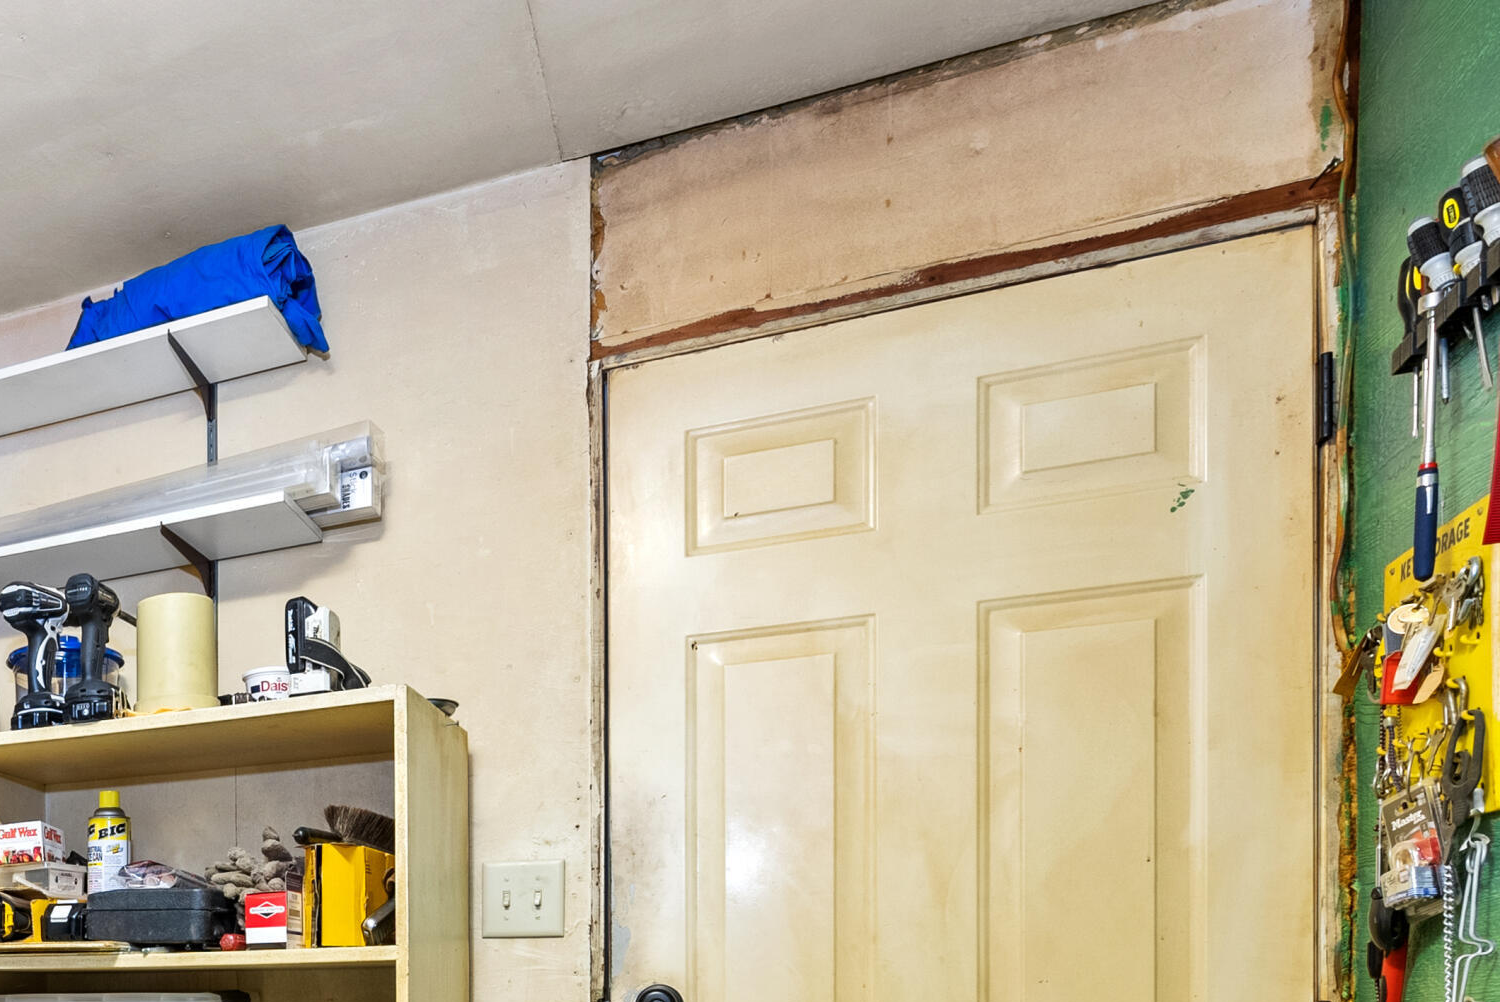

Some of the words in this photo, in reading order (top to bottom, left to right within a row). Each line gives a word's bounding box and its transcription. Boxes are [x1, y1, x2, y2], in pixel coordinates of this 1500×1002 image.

[1401, 557, 1414, 582] KE
[1435, 517, 1470, 557] ORAGE
[260, 680, 289, 692] Dais
[1391, 809, 1423, 832] Master
[18, 826, 37, 838] Wax
